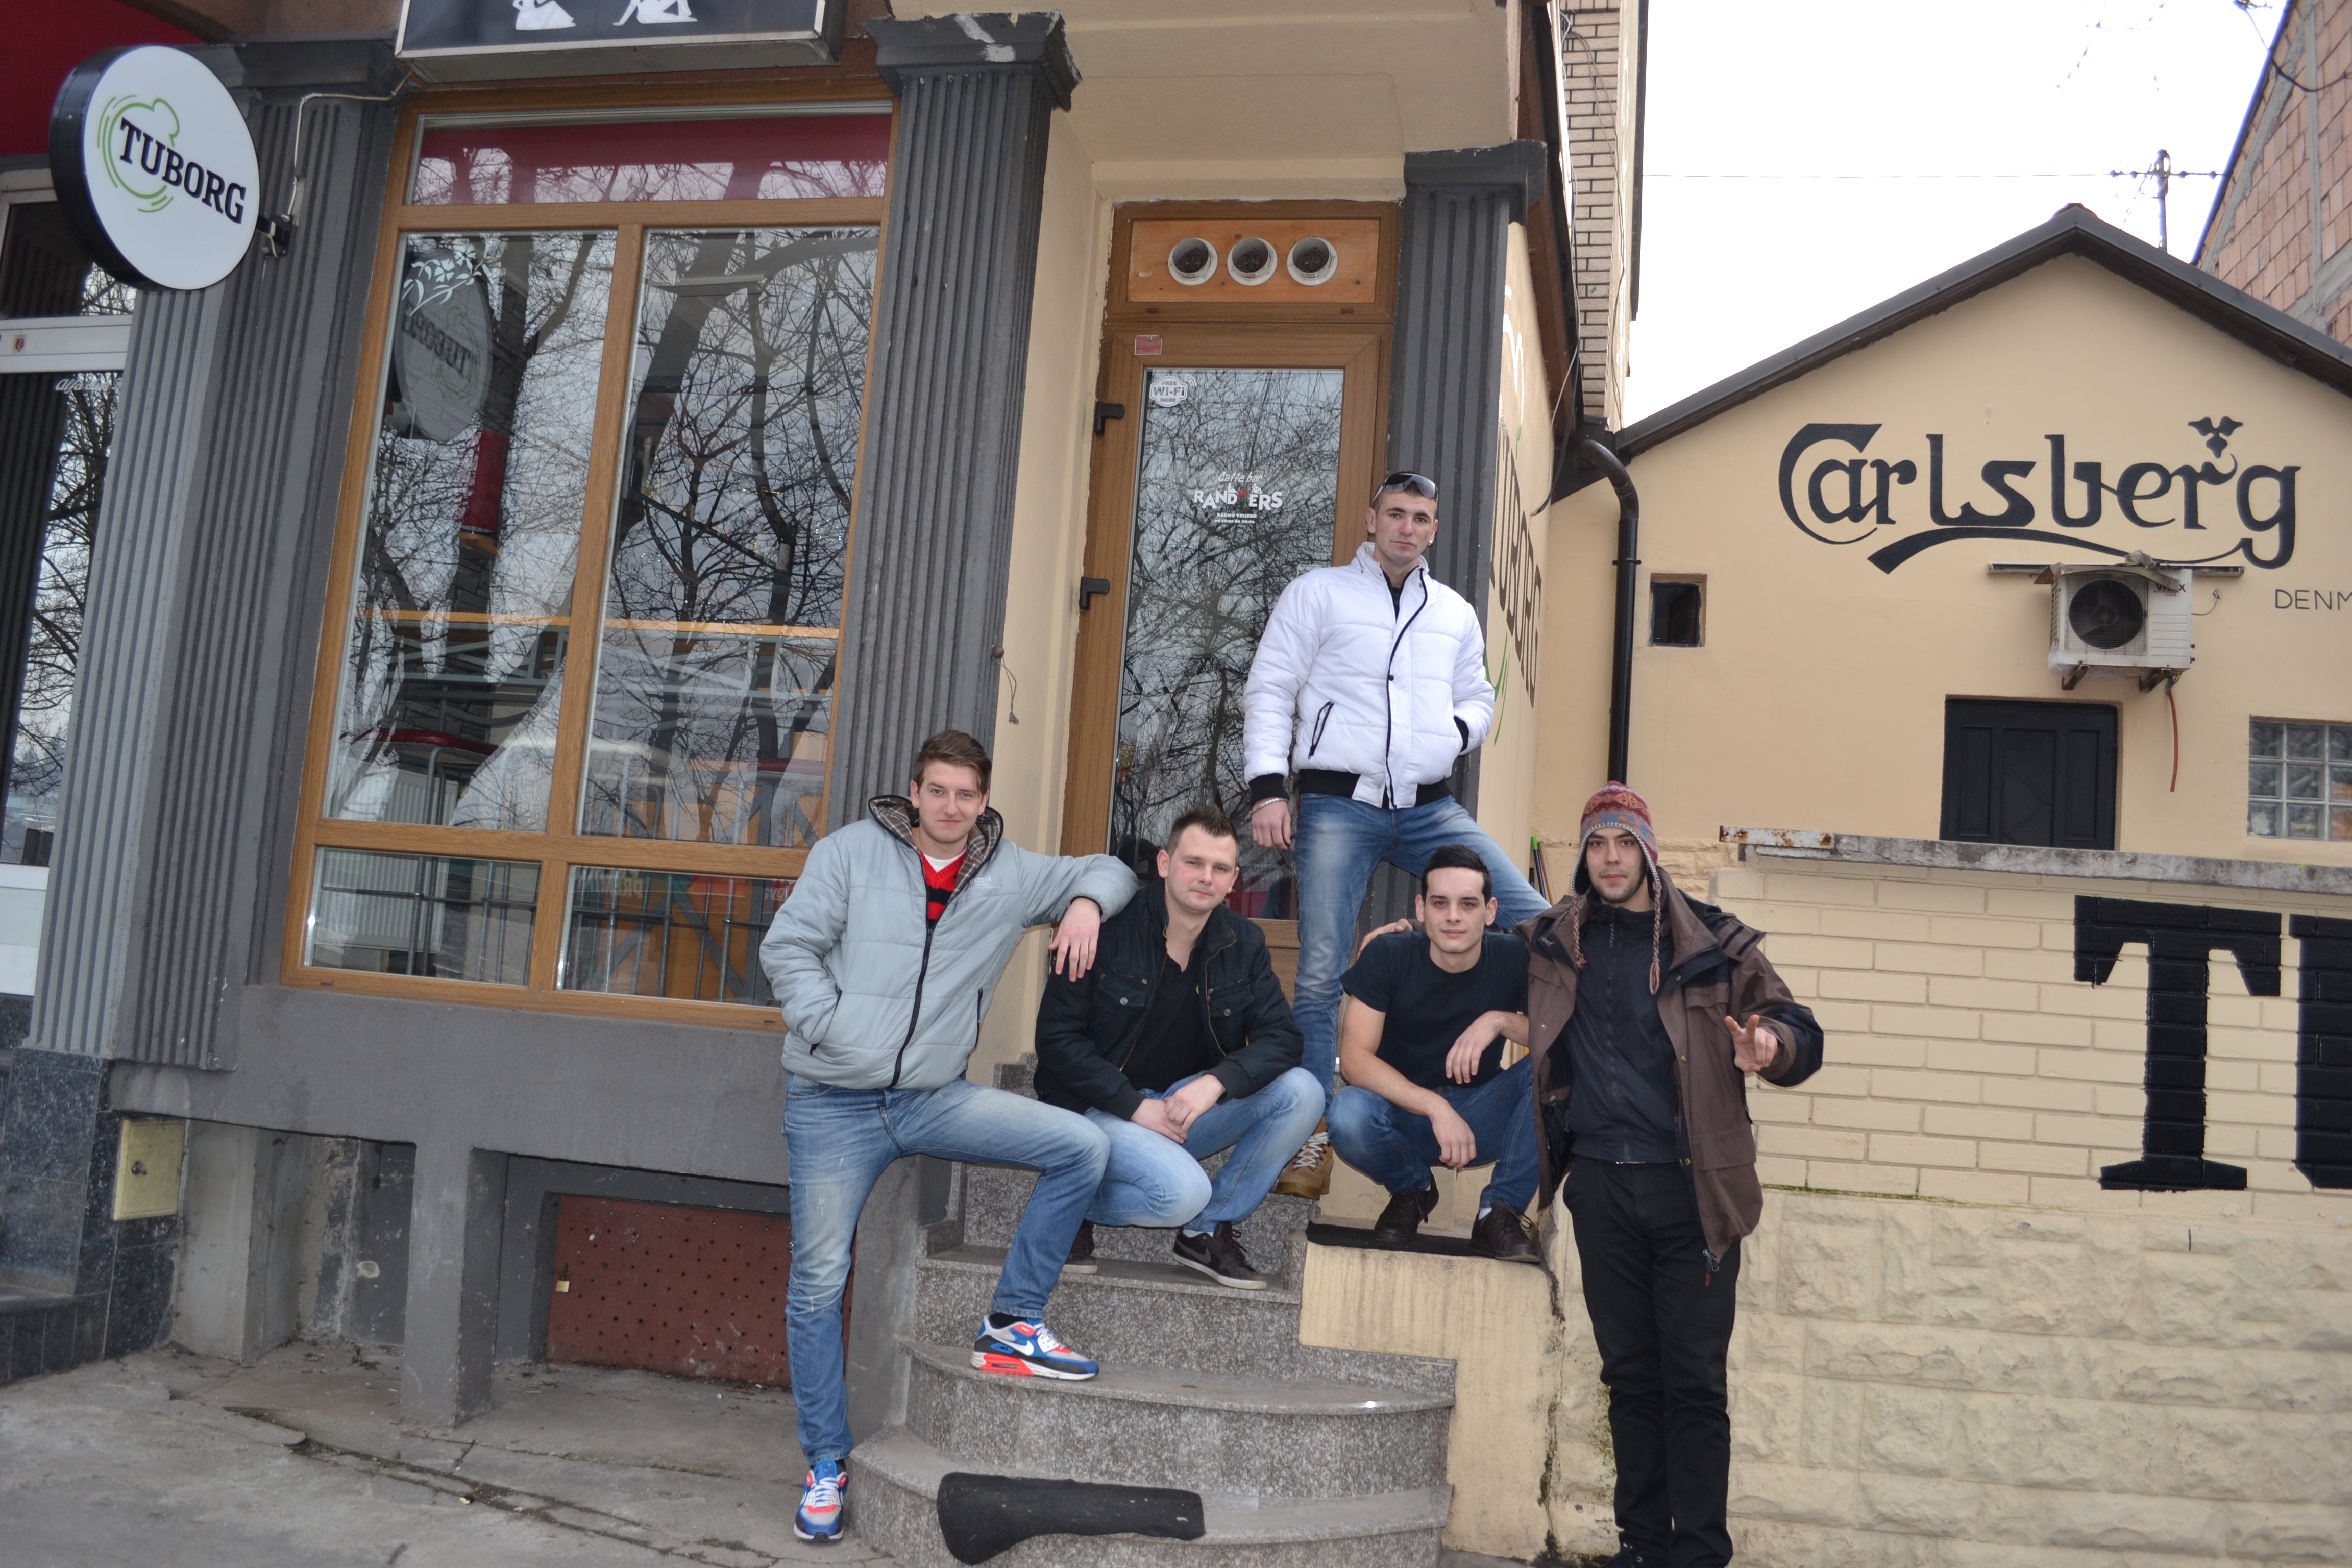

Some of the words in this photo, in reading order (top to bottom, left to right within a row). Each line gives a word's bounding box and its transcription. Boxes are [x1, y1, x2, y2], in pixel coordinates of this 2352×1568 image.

[120, 117, 246, 224] TUBORG
[1218, 471, 1245, 482] Caffe
[1246, 472, 1263, 483] bar
[1778, 423, 2301, 570] Carlsberg
[2275, 589, 2352, 610] DENM
